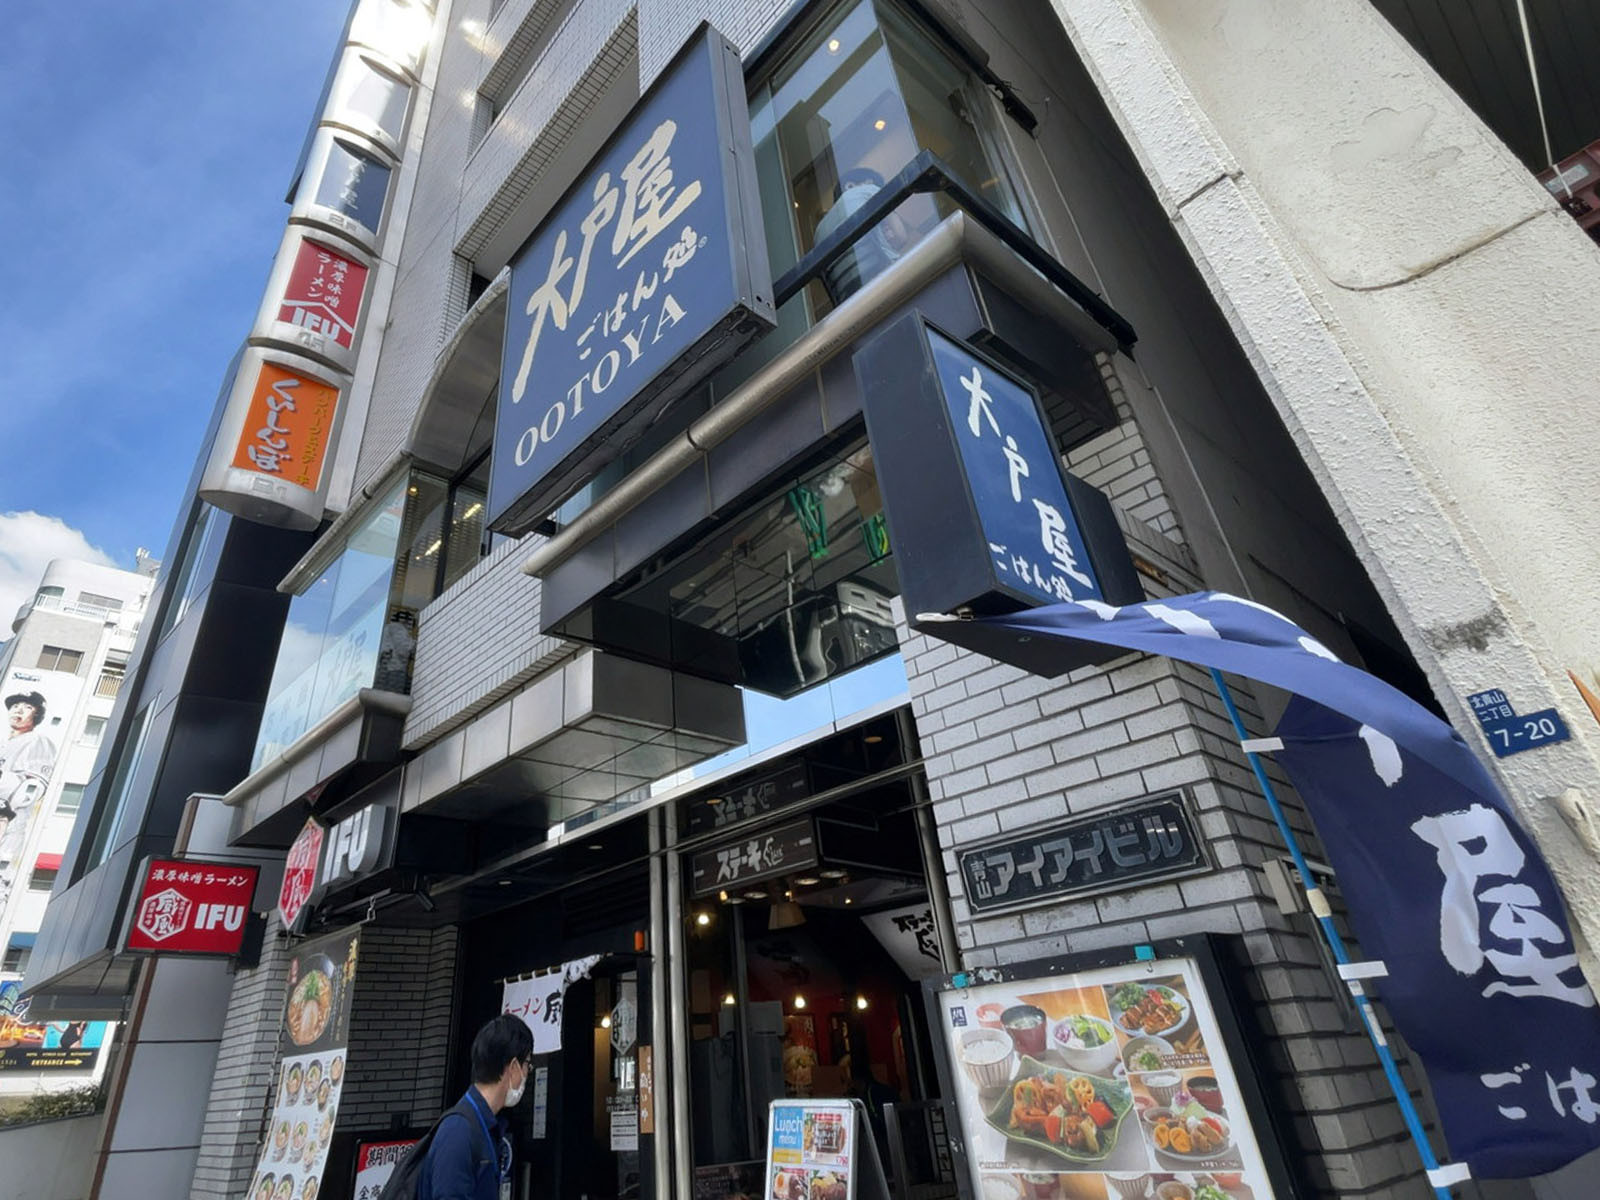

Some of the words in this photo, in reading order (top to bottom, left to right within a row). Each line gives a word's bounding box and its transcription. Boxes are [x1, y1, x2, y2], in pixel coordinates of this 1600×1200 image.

[306, 252, 332, 298] ラーメン
[292, 306, 341, 342] IFU
[514, 294, 688, 467] OOTOYA
[247, 378, 301, 472] くいしんぼ
[959, 366, 1094, 590] 大戸屋
[1479, 704, 1513, 722] 二丁目
[1493, 718, 1556, 748] 7-20
[320, 804, 378, 886] IFU
[986, 814, 1184, 897] アイアイビル
[151, 868, 249, 888] 濃厚味噌ラーメン
[193, 902, 245, 932] IFU
